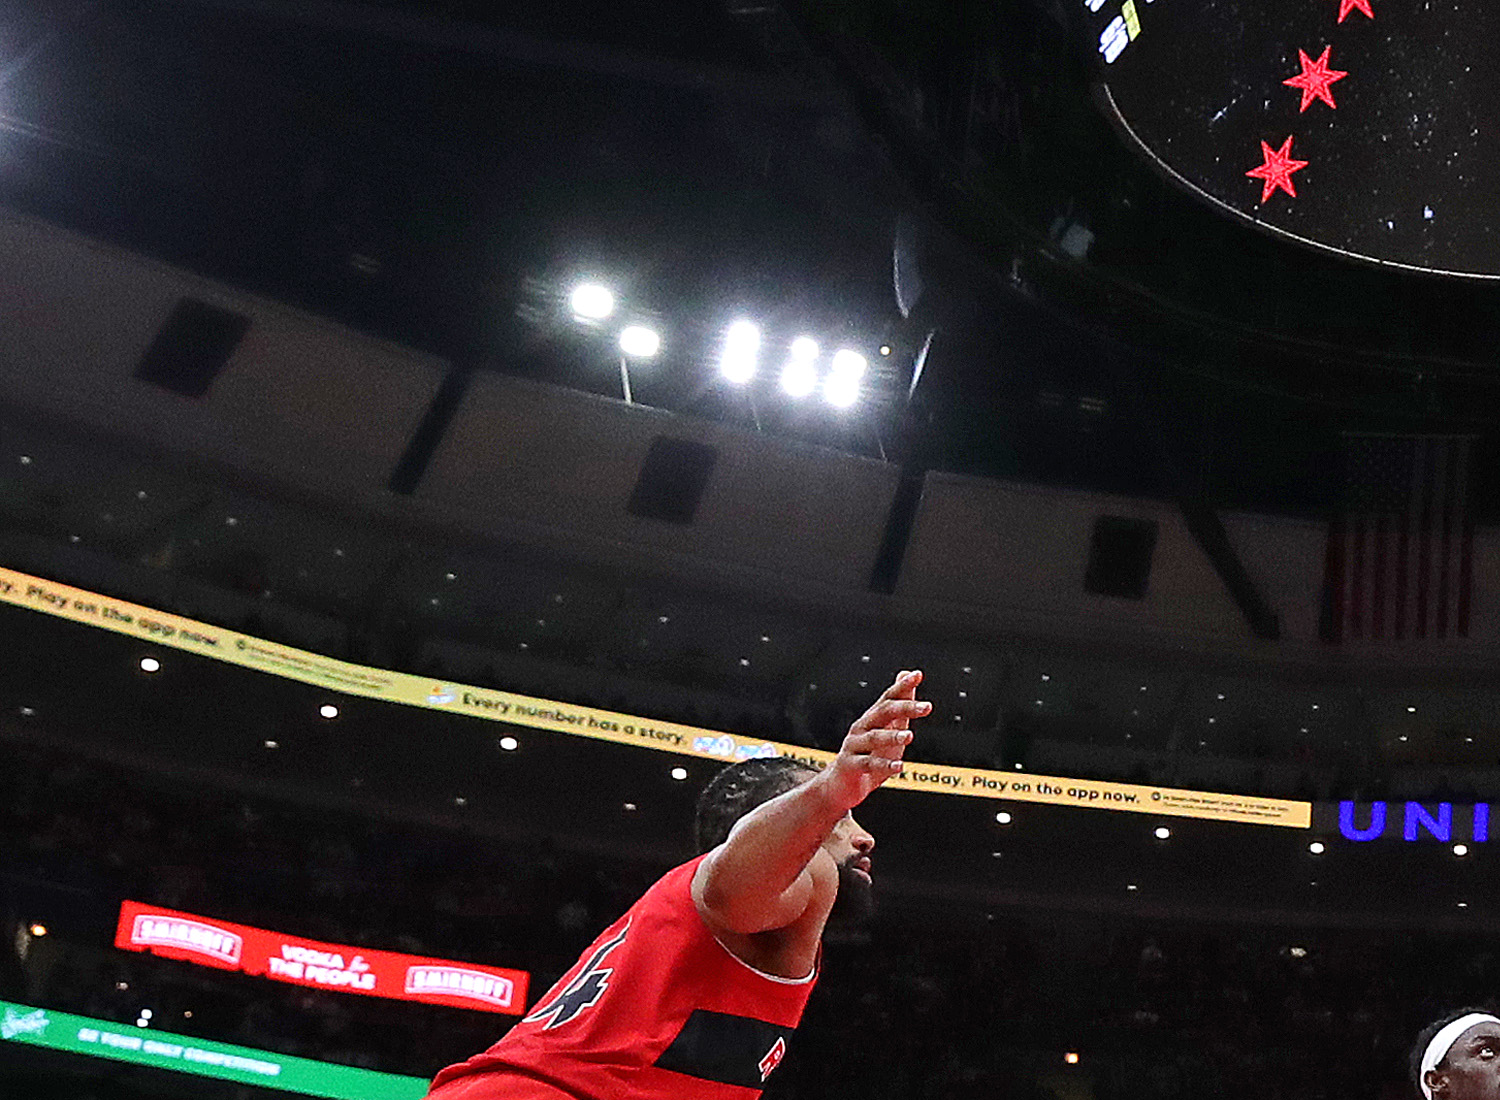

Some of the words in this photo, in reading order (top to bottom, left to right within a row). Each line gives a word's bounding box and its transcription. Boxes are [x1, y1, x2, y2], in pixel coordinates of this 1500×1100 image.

[461, 691, 511, 716] Every
[514, 702, 584, 728] number
[587, 714, 619, 733] has
[623, 724, 636, 736] a
[639, 726, 689, 747] story.
[912, 770, 966, 790] today.
[971, 775, 1008, 793] Play
[1011, 781, 1031, 793] on
[1036, 783, 1063, 797] the
[1066, 787, 1099, 802] app
[1103, 791, 1141, 804] now.
[269, 957, 303, 979] THE
[305, 964, 378, 991] PEOPLE
[281, 944, 345, 971] VODKA
